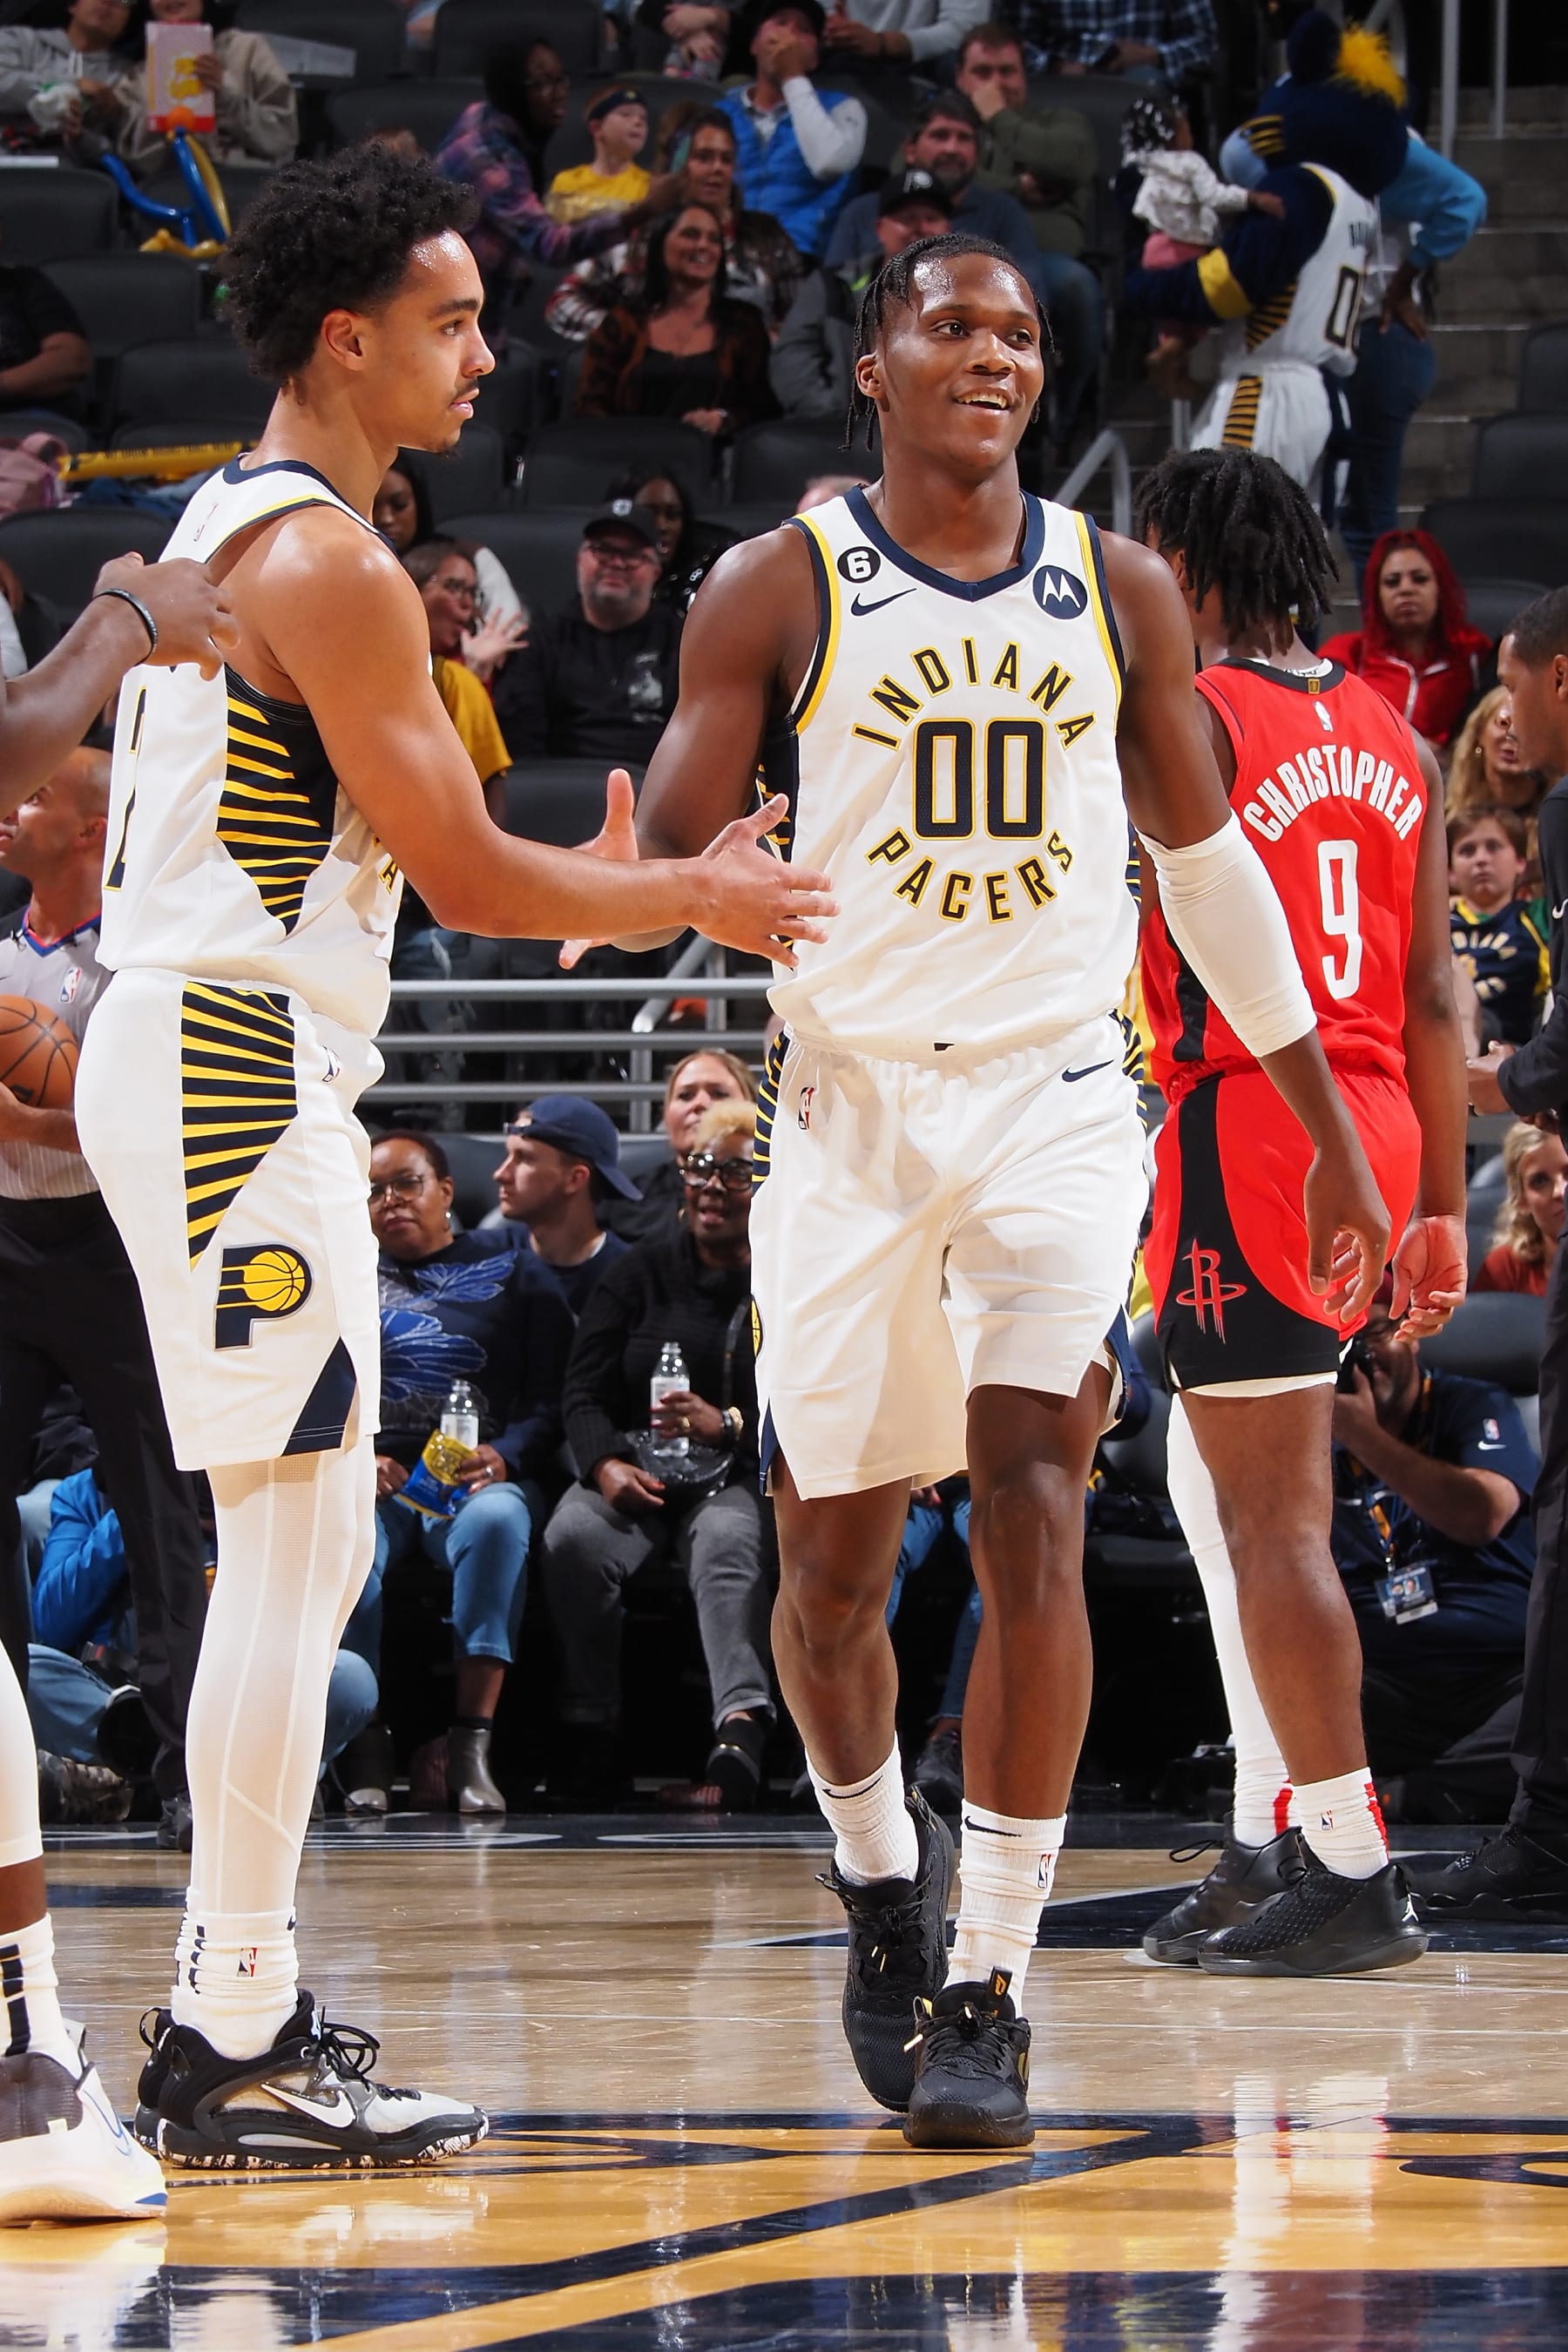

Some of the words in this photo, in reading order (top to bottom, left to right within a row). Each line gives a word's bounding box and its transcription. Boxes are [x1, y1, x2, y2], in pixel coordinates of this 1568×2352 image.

[1325, 265, 1361, 348] 0
[846, 551, 868, 577] 6
[853, 638, 1096, 751] INDIANA
[914, 719, 1046, 840] 00
[1244, 746, 1423, 841] CHRISTOPHER
[866, 828, 1073, 923] PACERS
[1317, 840, 1362, 999] 9
